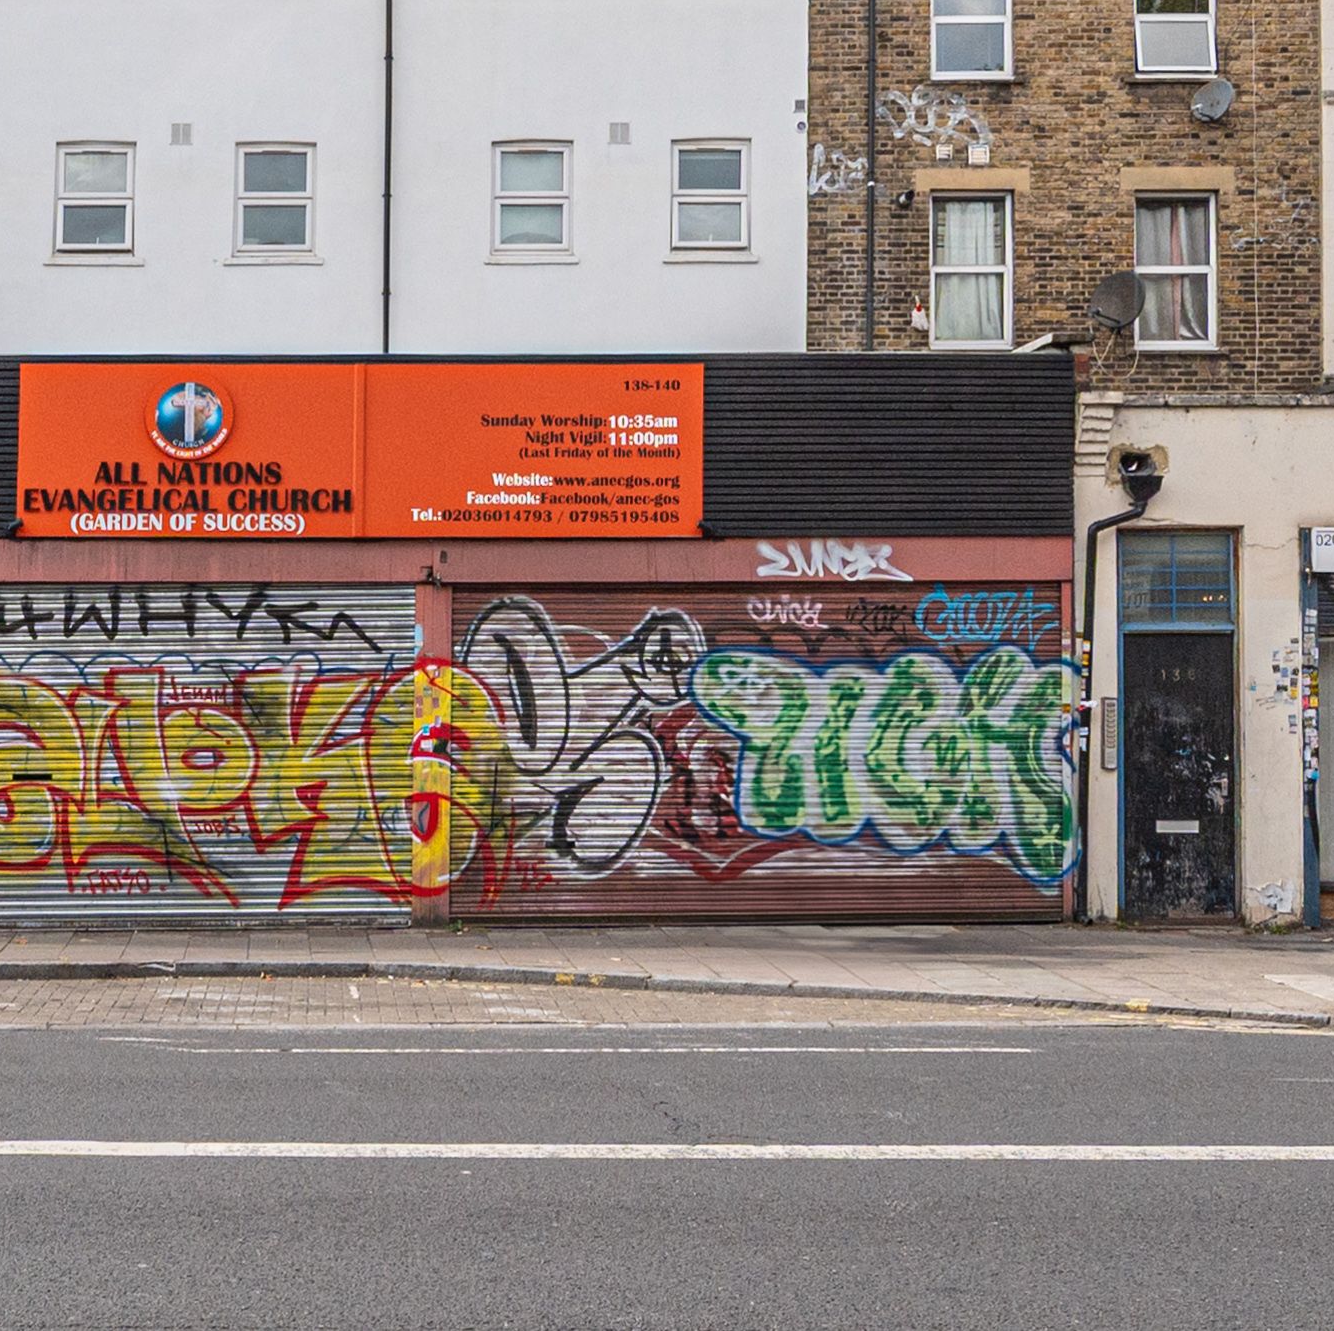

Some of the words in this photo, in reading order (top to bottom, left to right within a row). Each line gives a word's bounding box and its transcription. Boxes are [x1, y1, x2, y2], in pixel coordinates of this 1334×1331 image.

[624, 380, 680, 391] 138-140
[481, 414, 536, 429] Sunday
[609, 415, 678, 428] 10:35am
[526, 431, 564, 446] Night
[609, 432, 678, 447] 11:00pm
[519, 447, 550, 460] (Last
[554, 447, 592, 459] Friday
[597, 447, 609, 458] of
[613, 447, 633, 458] the
[638, 447, 681, 460] Month)
[94, 461, 147, 486] ALL
[157, 461, 282, 486] NATIONS
[23, 488, 218, 513] EVANGELICAL
[227, 488, 353, 513] CHURCH
[70, 513, 162, 534] (GARDEN
[169, 513, 197, 531] OF
[203, 513, 305, 534] SUCCESS)
